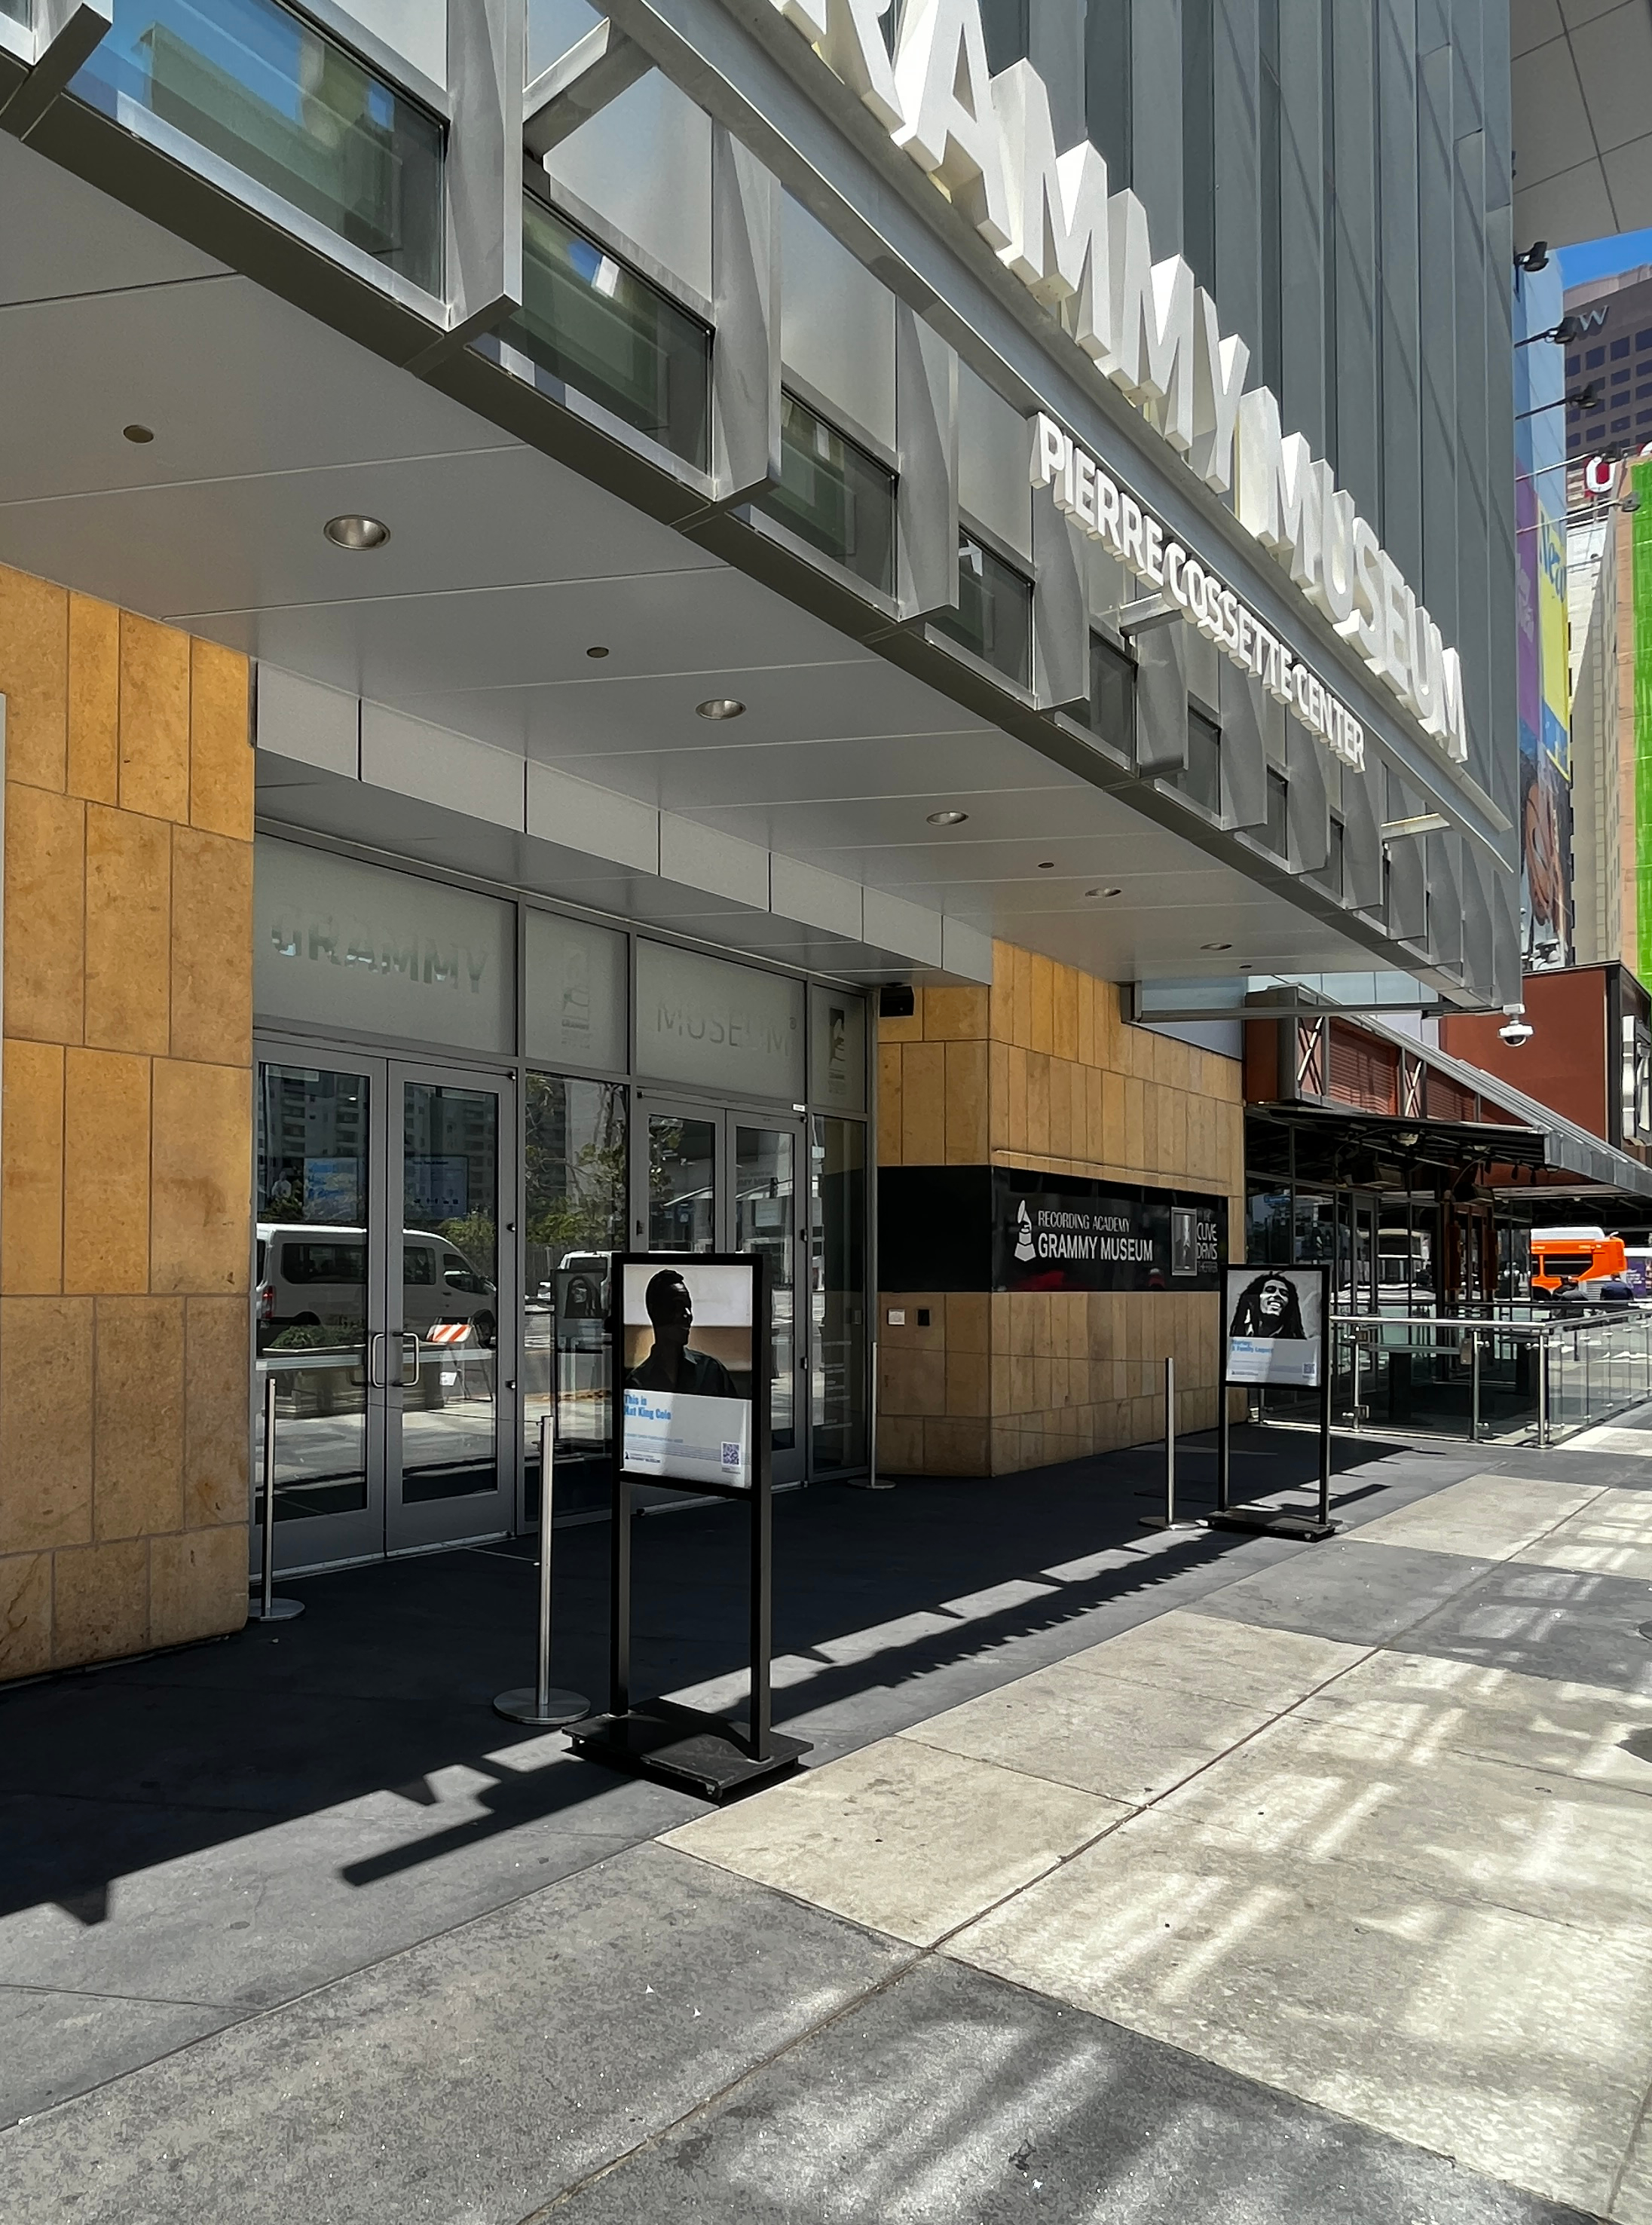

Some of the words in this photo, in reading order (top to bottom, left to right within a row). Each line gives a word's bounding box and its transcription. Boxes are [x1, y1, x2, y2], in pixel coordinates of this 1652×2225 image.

[1238, 385, 1469, 764] MUSEUM
[1029, 412, 1165, 591] PIERRE
[1161, 541, 1293, 705] COSSETTE
[1290, 663, 1366, 774] CENTER
[656, 1000, 790, 1057] MUSEM
[1038, 1210, 1090, 1230] RECORDING
[1093, 1215, 1130, 1233] ACADEMY
[1197, 1222, 1218, 1242] CLIVE
[1039, 1233, 1098, 1259] GRAMMY
[1100, 1236, 1153, 1262] MUSEUM
[1197, 1242, 1218, 1261] DAVIS
[624, 1394, 639, 1405] This
[641, 1396, 647, 1406] is
[638, 1406, 654, 1420] King
